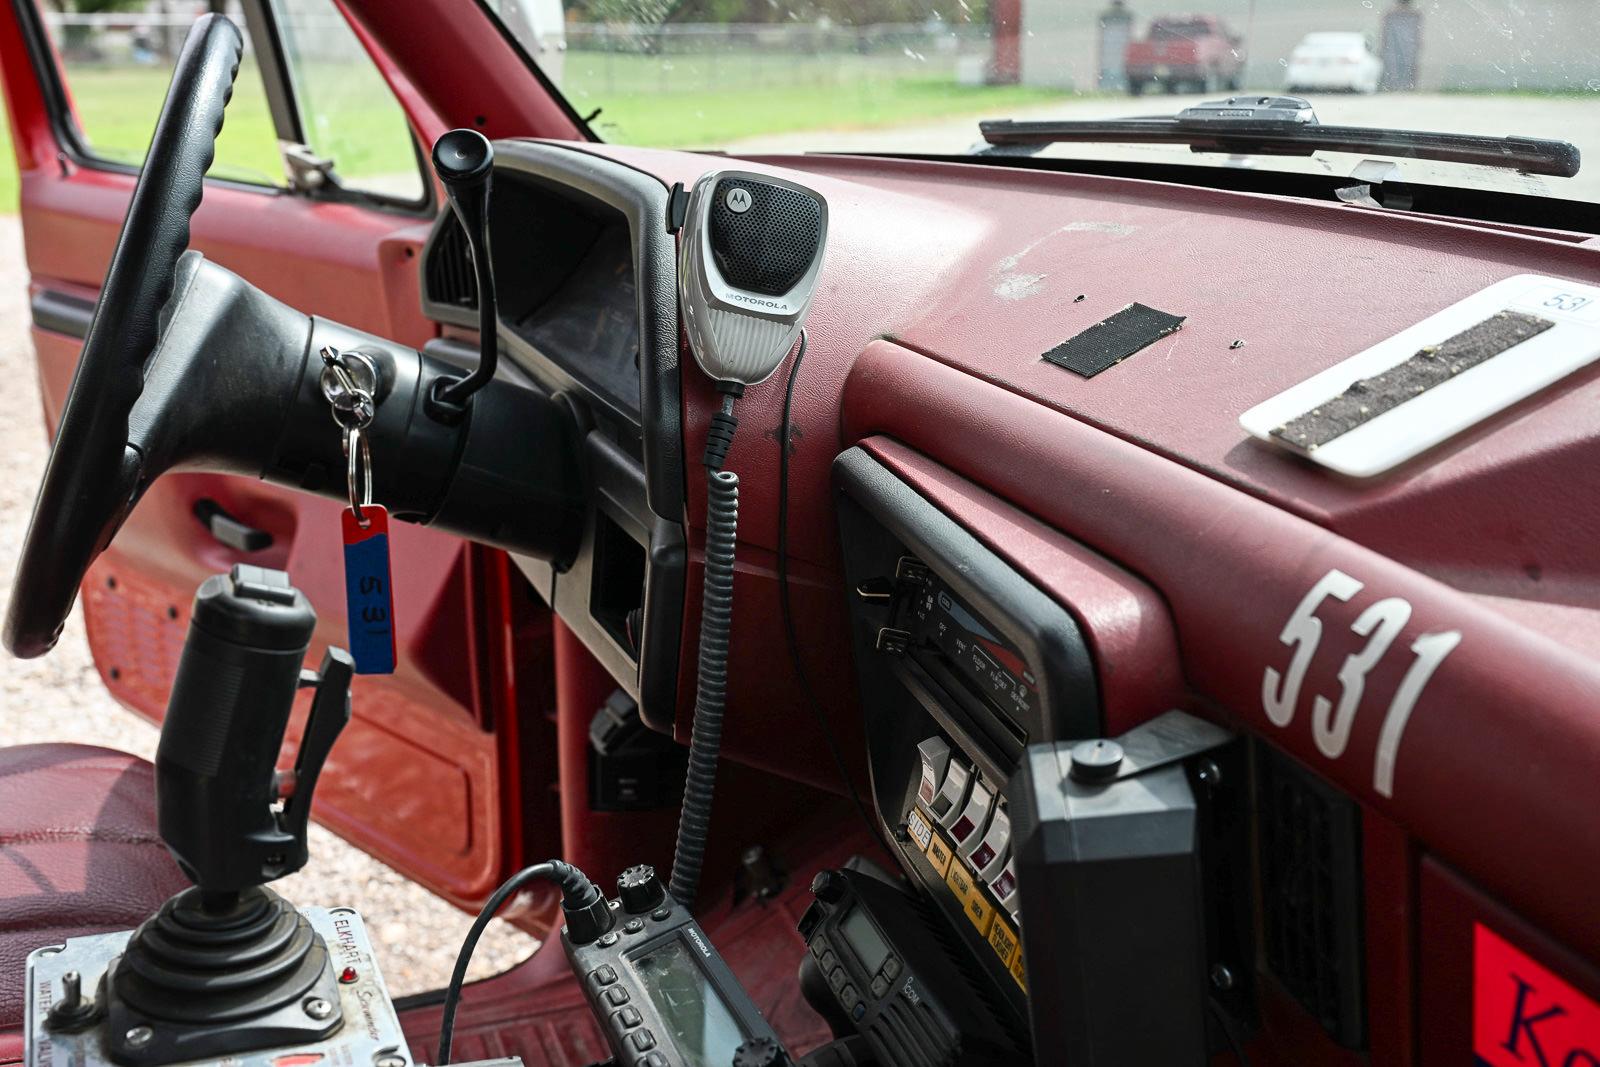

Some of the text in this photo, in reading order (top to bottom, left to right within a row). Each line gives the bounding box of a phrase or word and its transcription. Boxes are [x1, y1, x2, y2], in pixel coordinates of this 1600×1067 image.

[726, 293, 788, 310] MOTOROLA
[1543, 293, 1594, 312] 531
[1262, 568, 1463, 799] 531
[908, 812, 932, 846] SIDE
[334, 919, 362, 964] ELKHART
[688, 928, 711, 957] MOTOROLA
[38, 1040, 53, 1067] VALV
